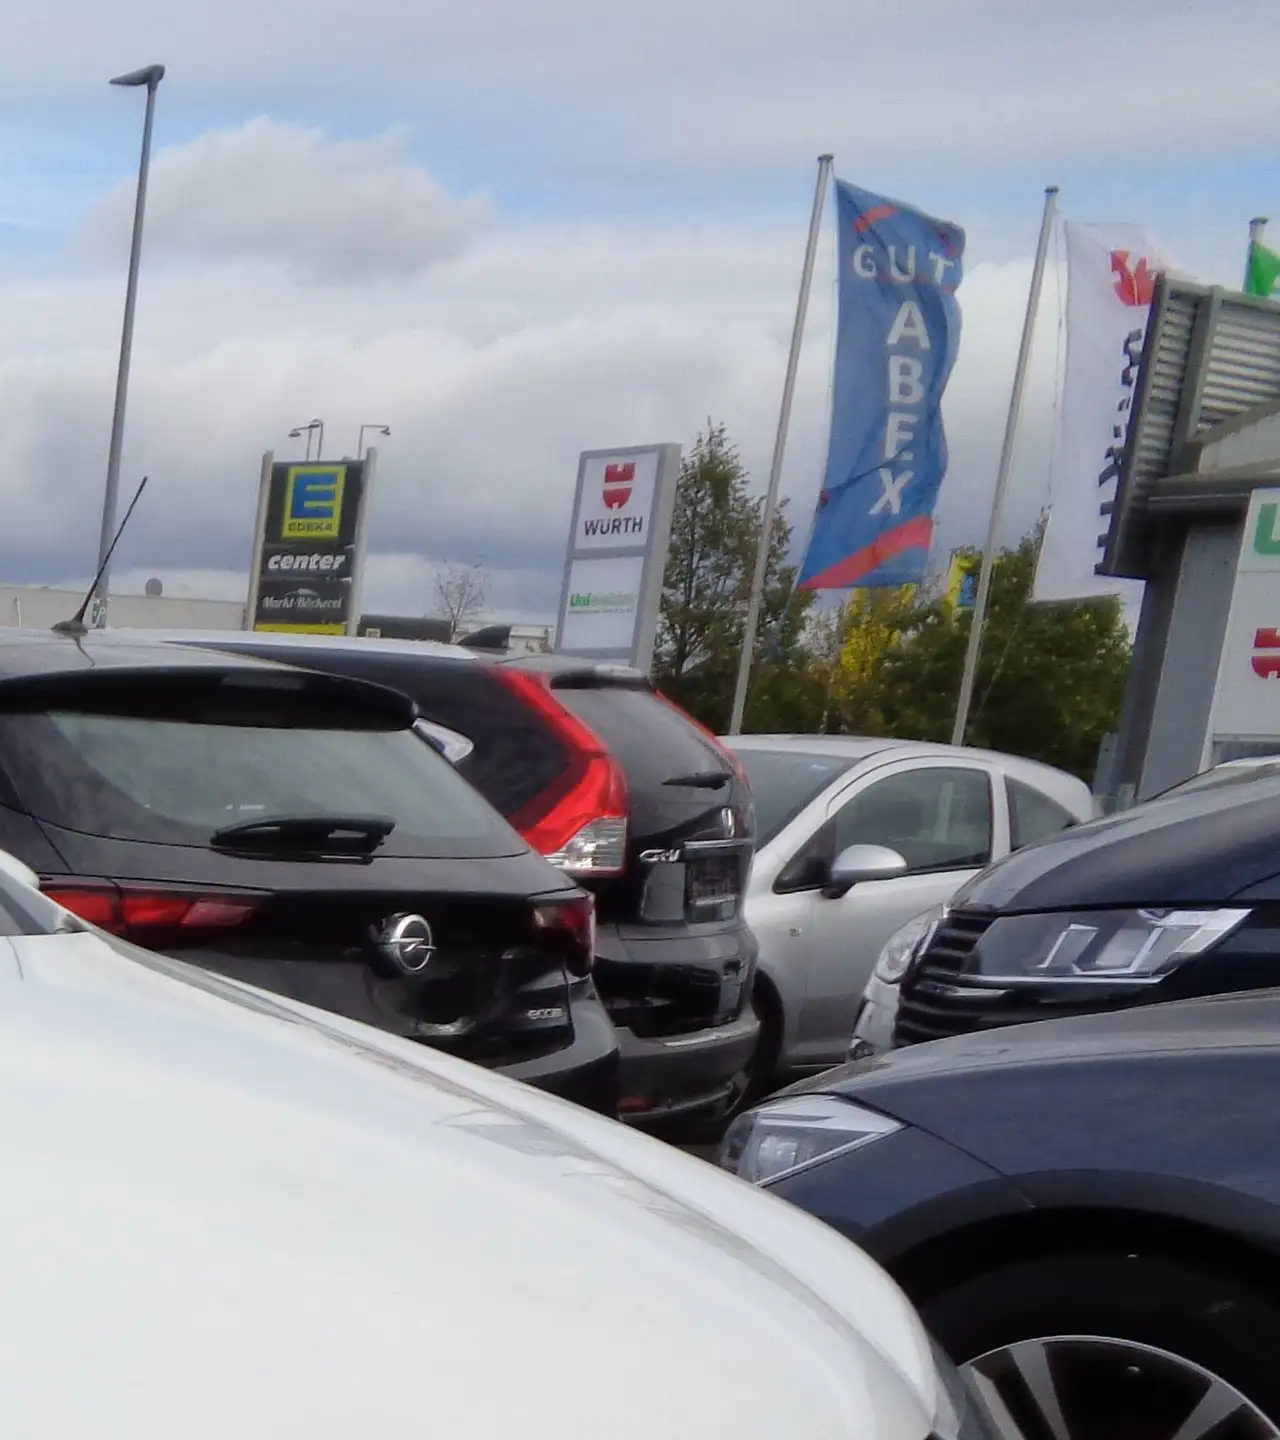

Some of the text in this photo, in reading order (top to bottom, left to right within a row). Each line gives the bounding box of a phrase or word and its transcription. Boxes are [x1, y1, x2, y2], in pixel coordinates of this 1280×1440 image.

[853, 244, 954, 284] GUT
[287, 522, 333, 532] EDEKA
[268, 553, 346, 570] center
